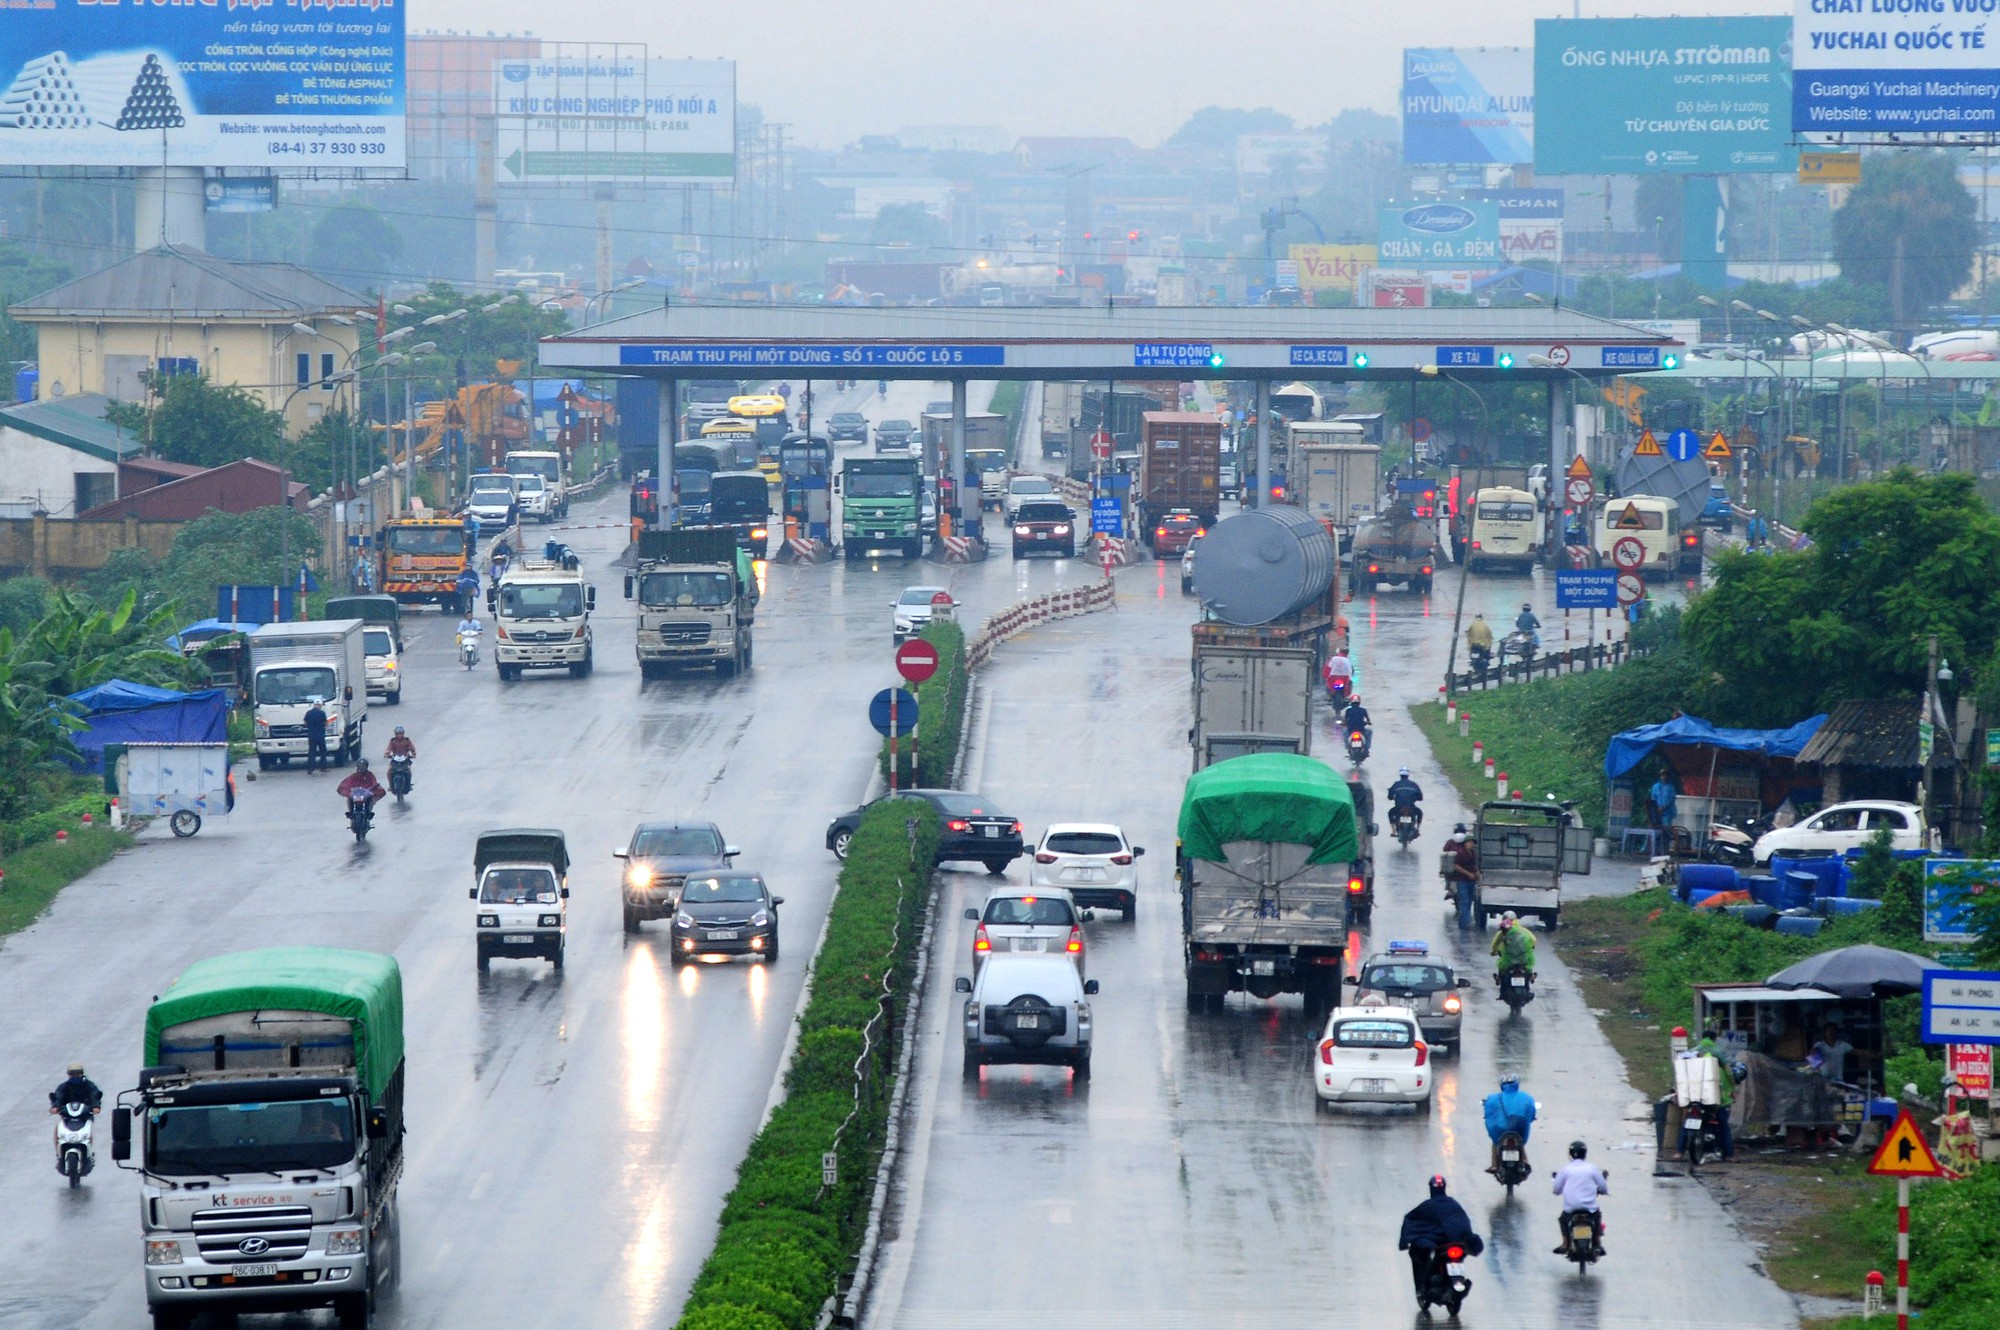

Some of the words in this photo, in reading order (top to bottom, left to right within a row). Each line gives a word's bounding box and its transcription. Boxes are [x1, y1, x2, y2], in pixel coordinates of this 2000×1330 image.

[251, 22, 279, 35] tảng
[376, 22, 391, 33] lai
[1810, 31, 1887, 49] YUCHAI
[1894, 23, 1953, 50] QUỐC
[1960, 23, 1987, 49] TẾ
[1562, 46, 1606, 66] ỐNG
[1612, 49, 1670, 69] NHỰA
[347, 79, 393, 88] ASPHALT
[1741, 73, 1770, 83] HDPE
[1809, 81, 1870, 99] Guangxi
[1873, 81, 1922, 96] Yuchai
[1926, 81, 2000, 99] Machinery
[510, 97, 539, 113] KHU
[707, 100, 717, 114] A
[1407, 96, 1486, 113] HYUNDAI
[1809, 106, 1871, 120] Website:
[1876, 106, 1996, 124] www.yuchai.com
[219, 122, 260, 135] Website:
[263, 123, 386, 136] www.betonghathanh.com
[661, 121, 690, 130] PARK
[1648, 117, 1707, 132] CHUYÊN
[1711, 118, 1736, 131] GIA
[268, 142, 306, 155] (84-4)
[310, 142, 326, 154] 37
[330, 142, 356, 155] 930
[360, 142, 386, 155] 930
[1433, 242, 1454, 257] GA
[653, 350, 693, 364] TRẠM
[697, 350, 726, 362] THU
[729, 347, 753, 362] PHÍ
[756, 347, 786, 364] MỘT
[790, 346, 831, 362] DỪNG
[843, 346, 863, 362] SỐ
[867, 351, 874, 362] 1
[886, 345, 926, 363] QUỐC
[932, 347, 950, 364] LỘ
[954, 351, 962, 362] 5
[1451, 352, 1463, 363] XE
[1605, 353, 1616, 364] XE
[212, 1194, 228, 1207] kt
[233, 1195, 275, 1207] service
